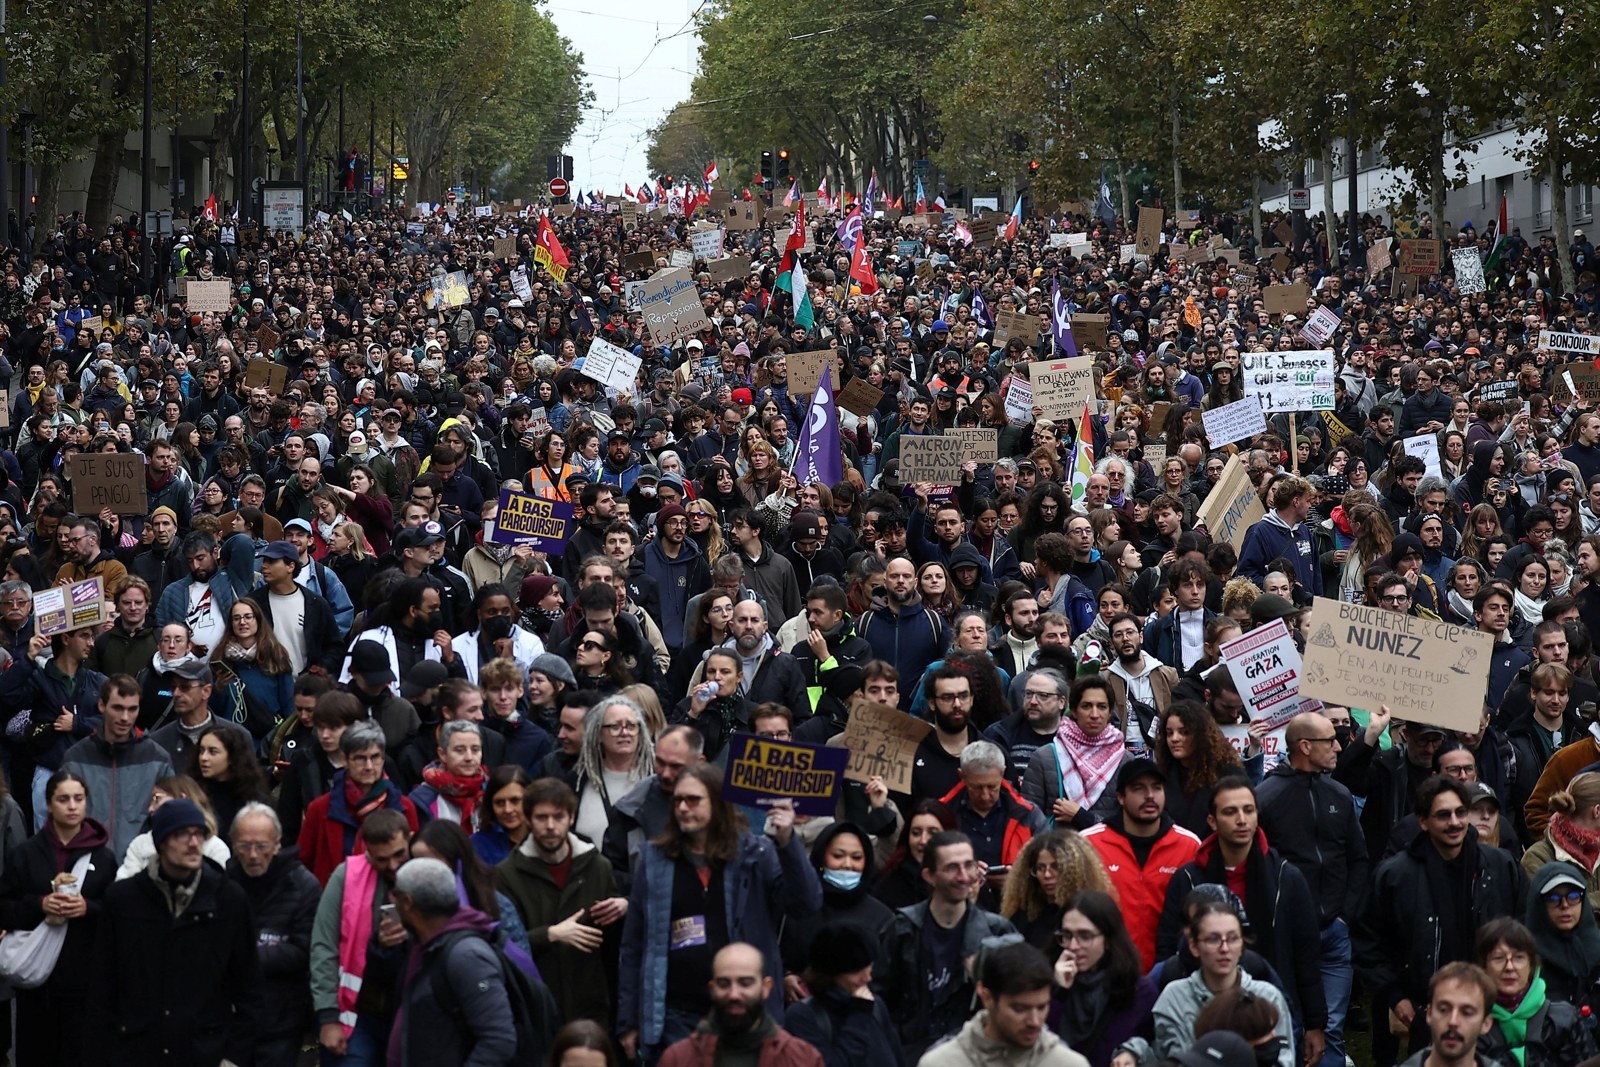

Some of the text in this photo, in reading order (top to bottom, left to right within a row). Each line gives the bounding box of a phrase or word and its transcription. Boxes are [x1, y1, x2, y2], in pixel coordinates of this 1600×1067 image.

[638, 279, 696, 306] Revendications
[655, 319, 705, 344] Explosion
[1316, 317, 1330, 330] GAZA
[1549, 334, 1591, 351] BONJOUR
[1241, 354, 1328, 371] UNE Jeunesse
[1055, 409, 1072, 417] ZOT
[1323, 411, 1331, 424] LE
[1328, 420, 1344, 436] BAC
[904, 438, 962, 452] MACRON
[903, 452, 962, 468] CHIASSE
[970, 451, 994, 460] DROIT
[80, 459, 134, 480] JE SUIS
[899, 468, 963, 482] INFERNALE
[91, 483, 131, 505] PENGO
[509, 494, 551, 518] À BAS
[500, 511, 564, 537] PARCOURSUP
[1339, 603, 1418, 635] BOUCHERIE
[1346, 625, 1424, 660] NUNEZ
[1245, 653, 1284, 679] GAZA
[1368, 659, 1378, 669] A
[1382, 662, 1397, 676] UN
[1401, 667, 1422, 679] PEU
[1425, 671, 1450, 684] PLUS
[1335, 668, 1352, 683] JE
[1357, 673, 1386, 688] VOUS
[1345, 685, 1387, 702] QUAND
[766, 748, 811, 771] BAS
[734, 762, 833, 794] PARCOURSUP
